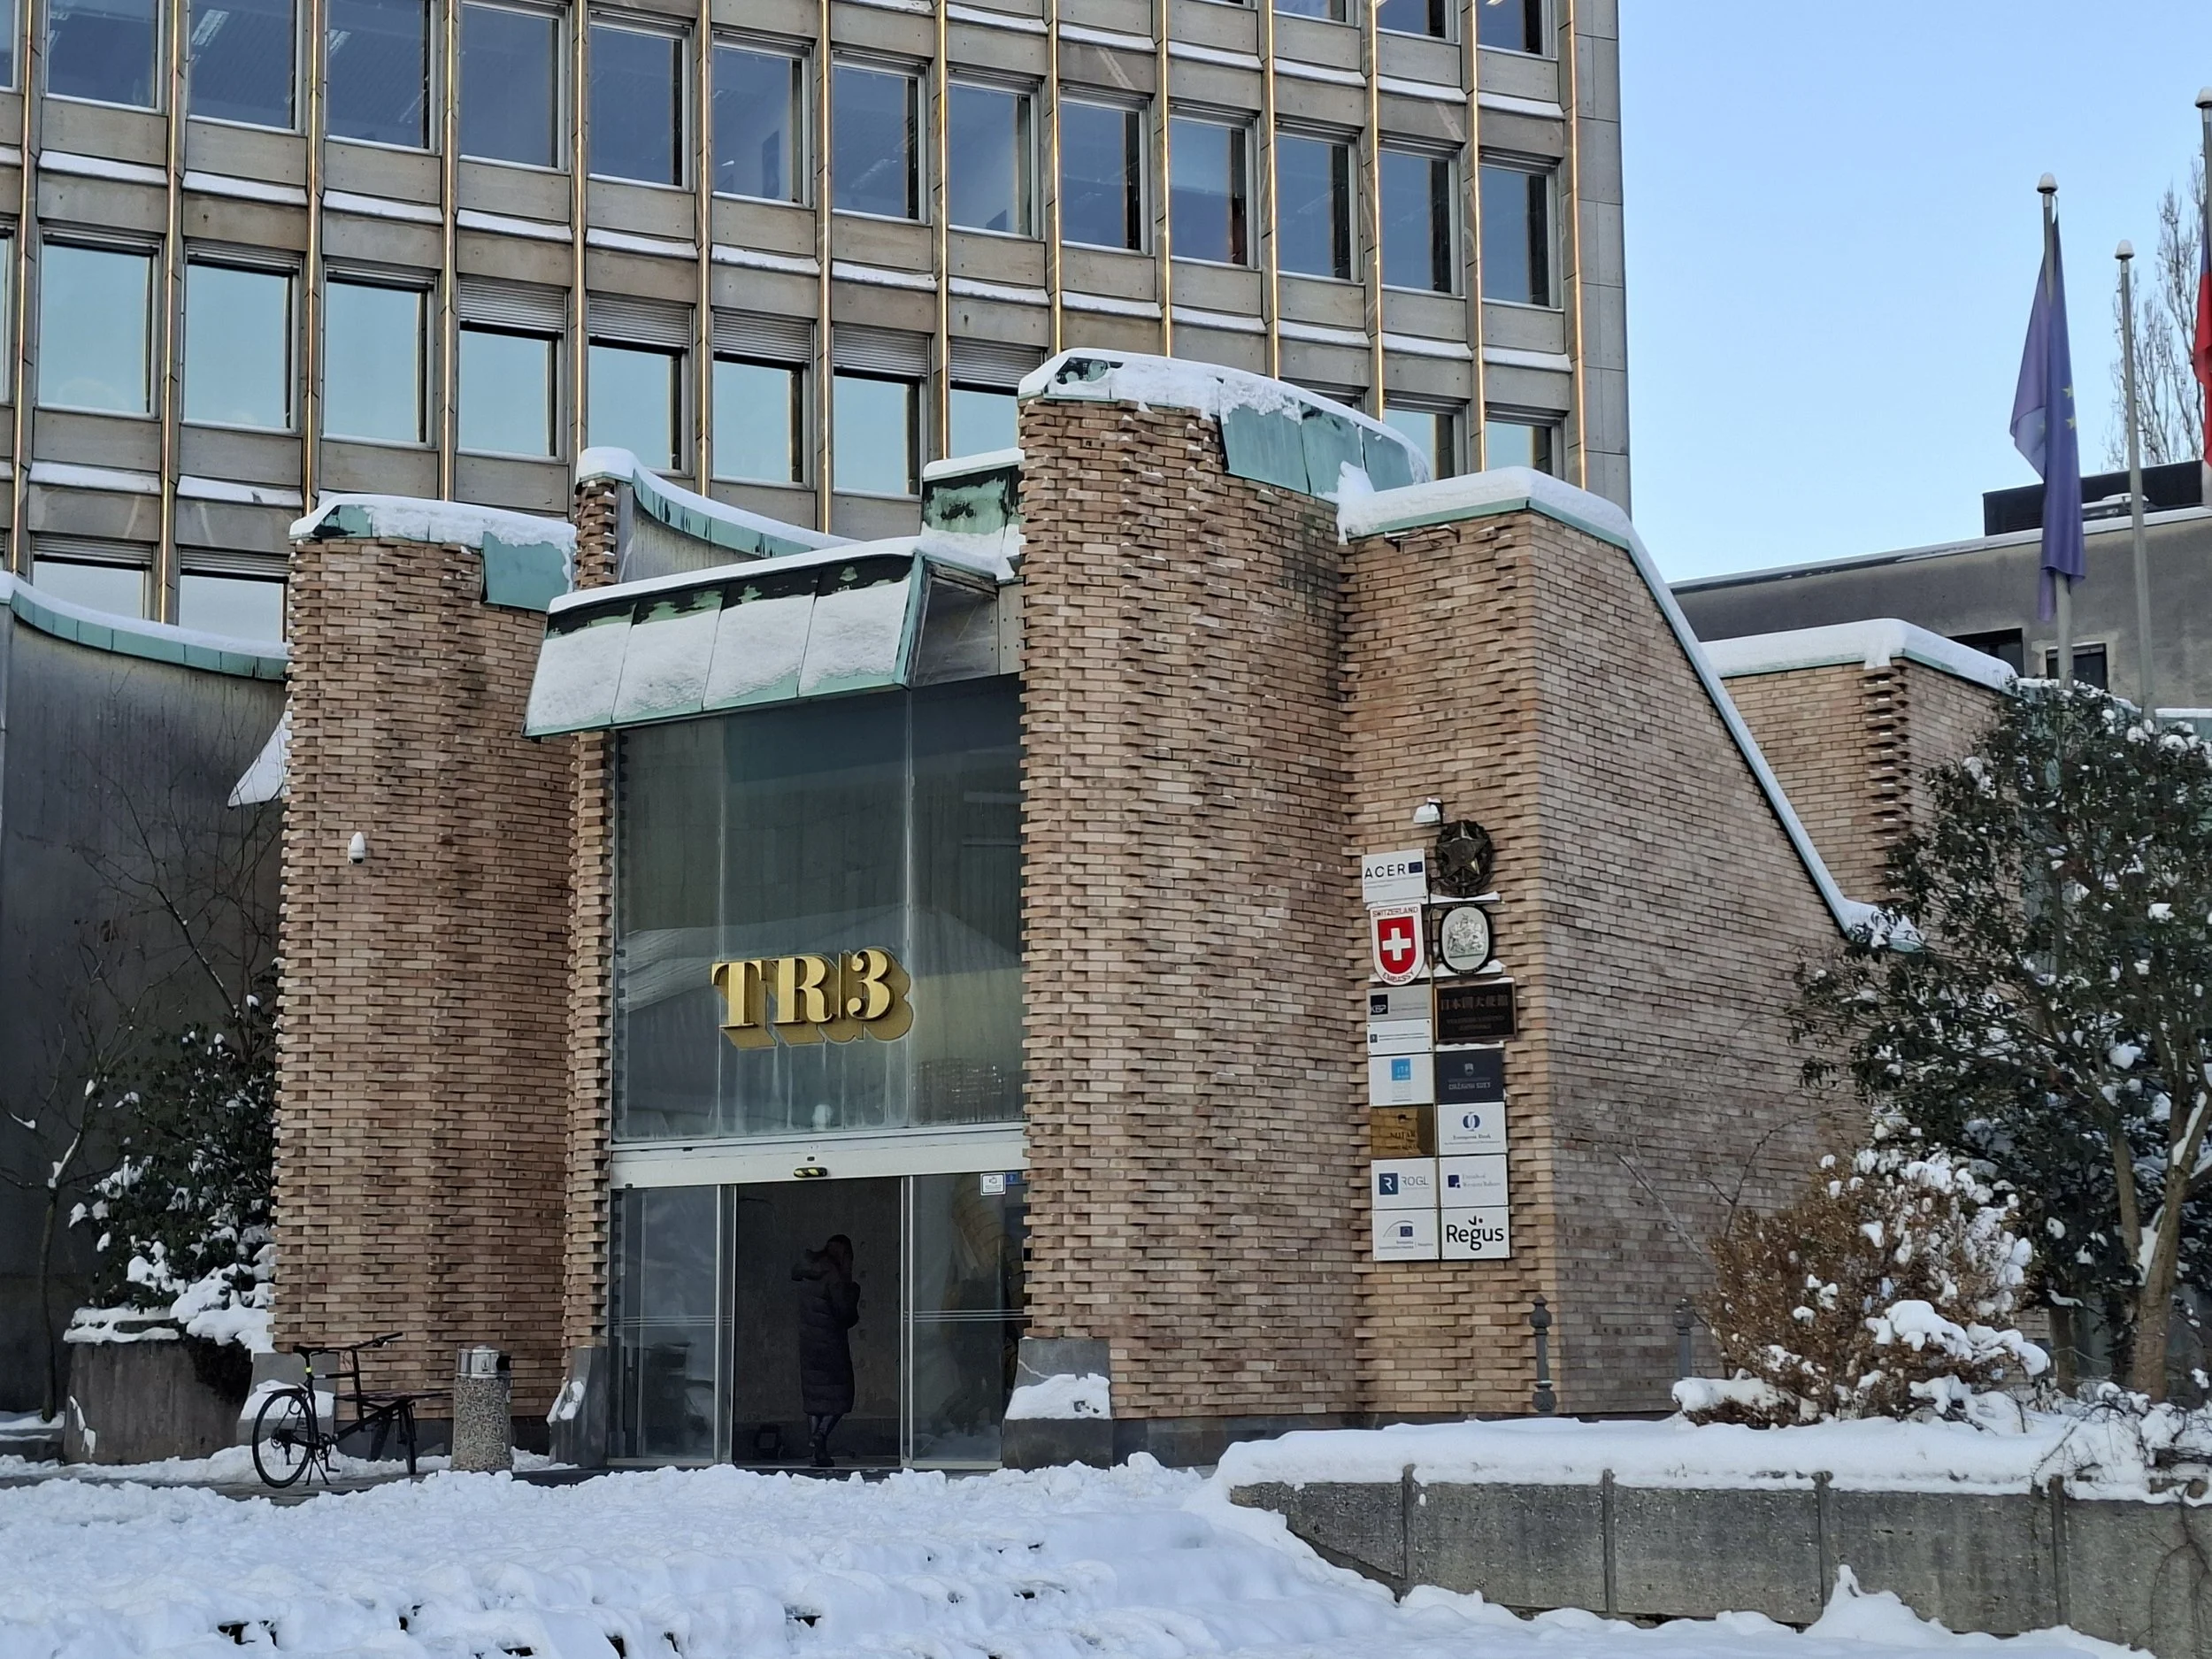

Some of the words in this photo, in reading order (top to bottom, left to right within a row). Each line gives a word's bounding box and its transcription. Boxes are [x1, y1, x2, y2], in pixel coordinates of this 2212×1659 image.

[1364, 864, 1406, 879] ACER
[1372, 906, 1418, 918] SWITZERLAND
[711, 948, 895, 1029] TR3
[1401, 1175, 1430, 1187] ROGL
[1446, 1225, 1504, 1251] Regus
